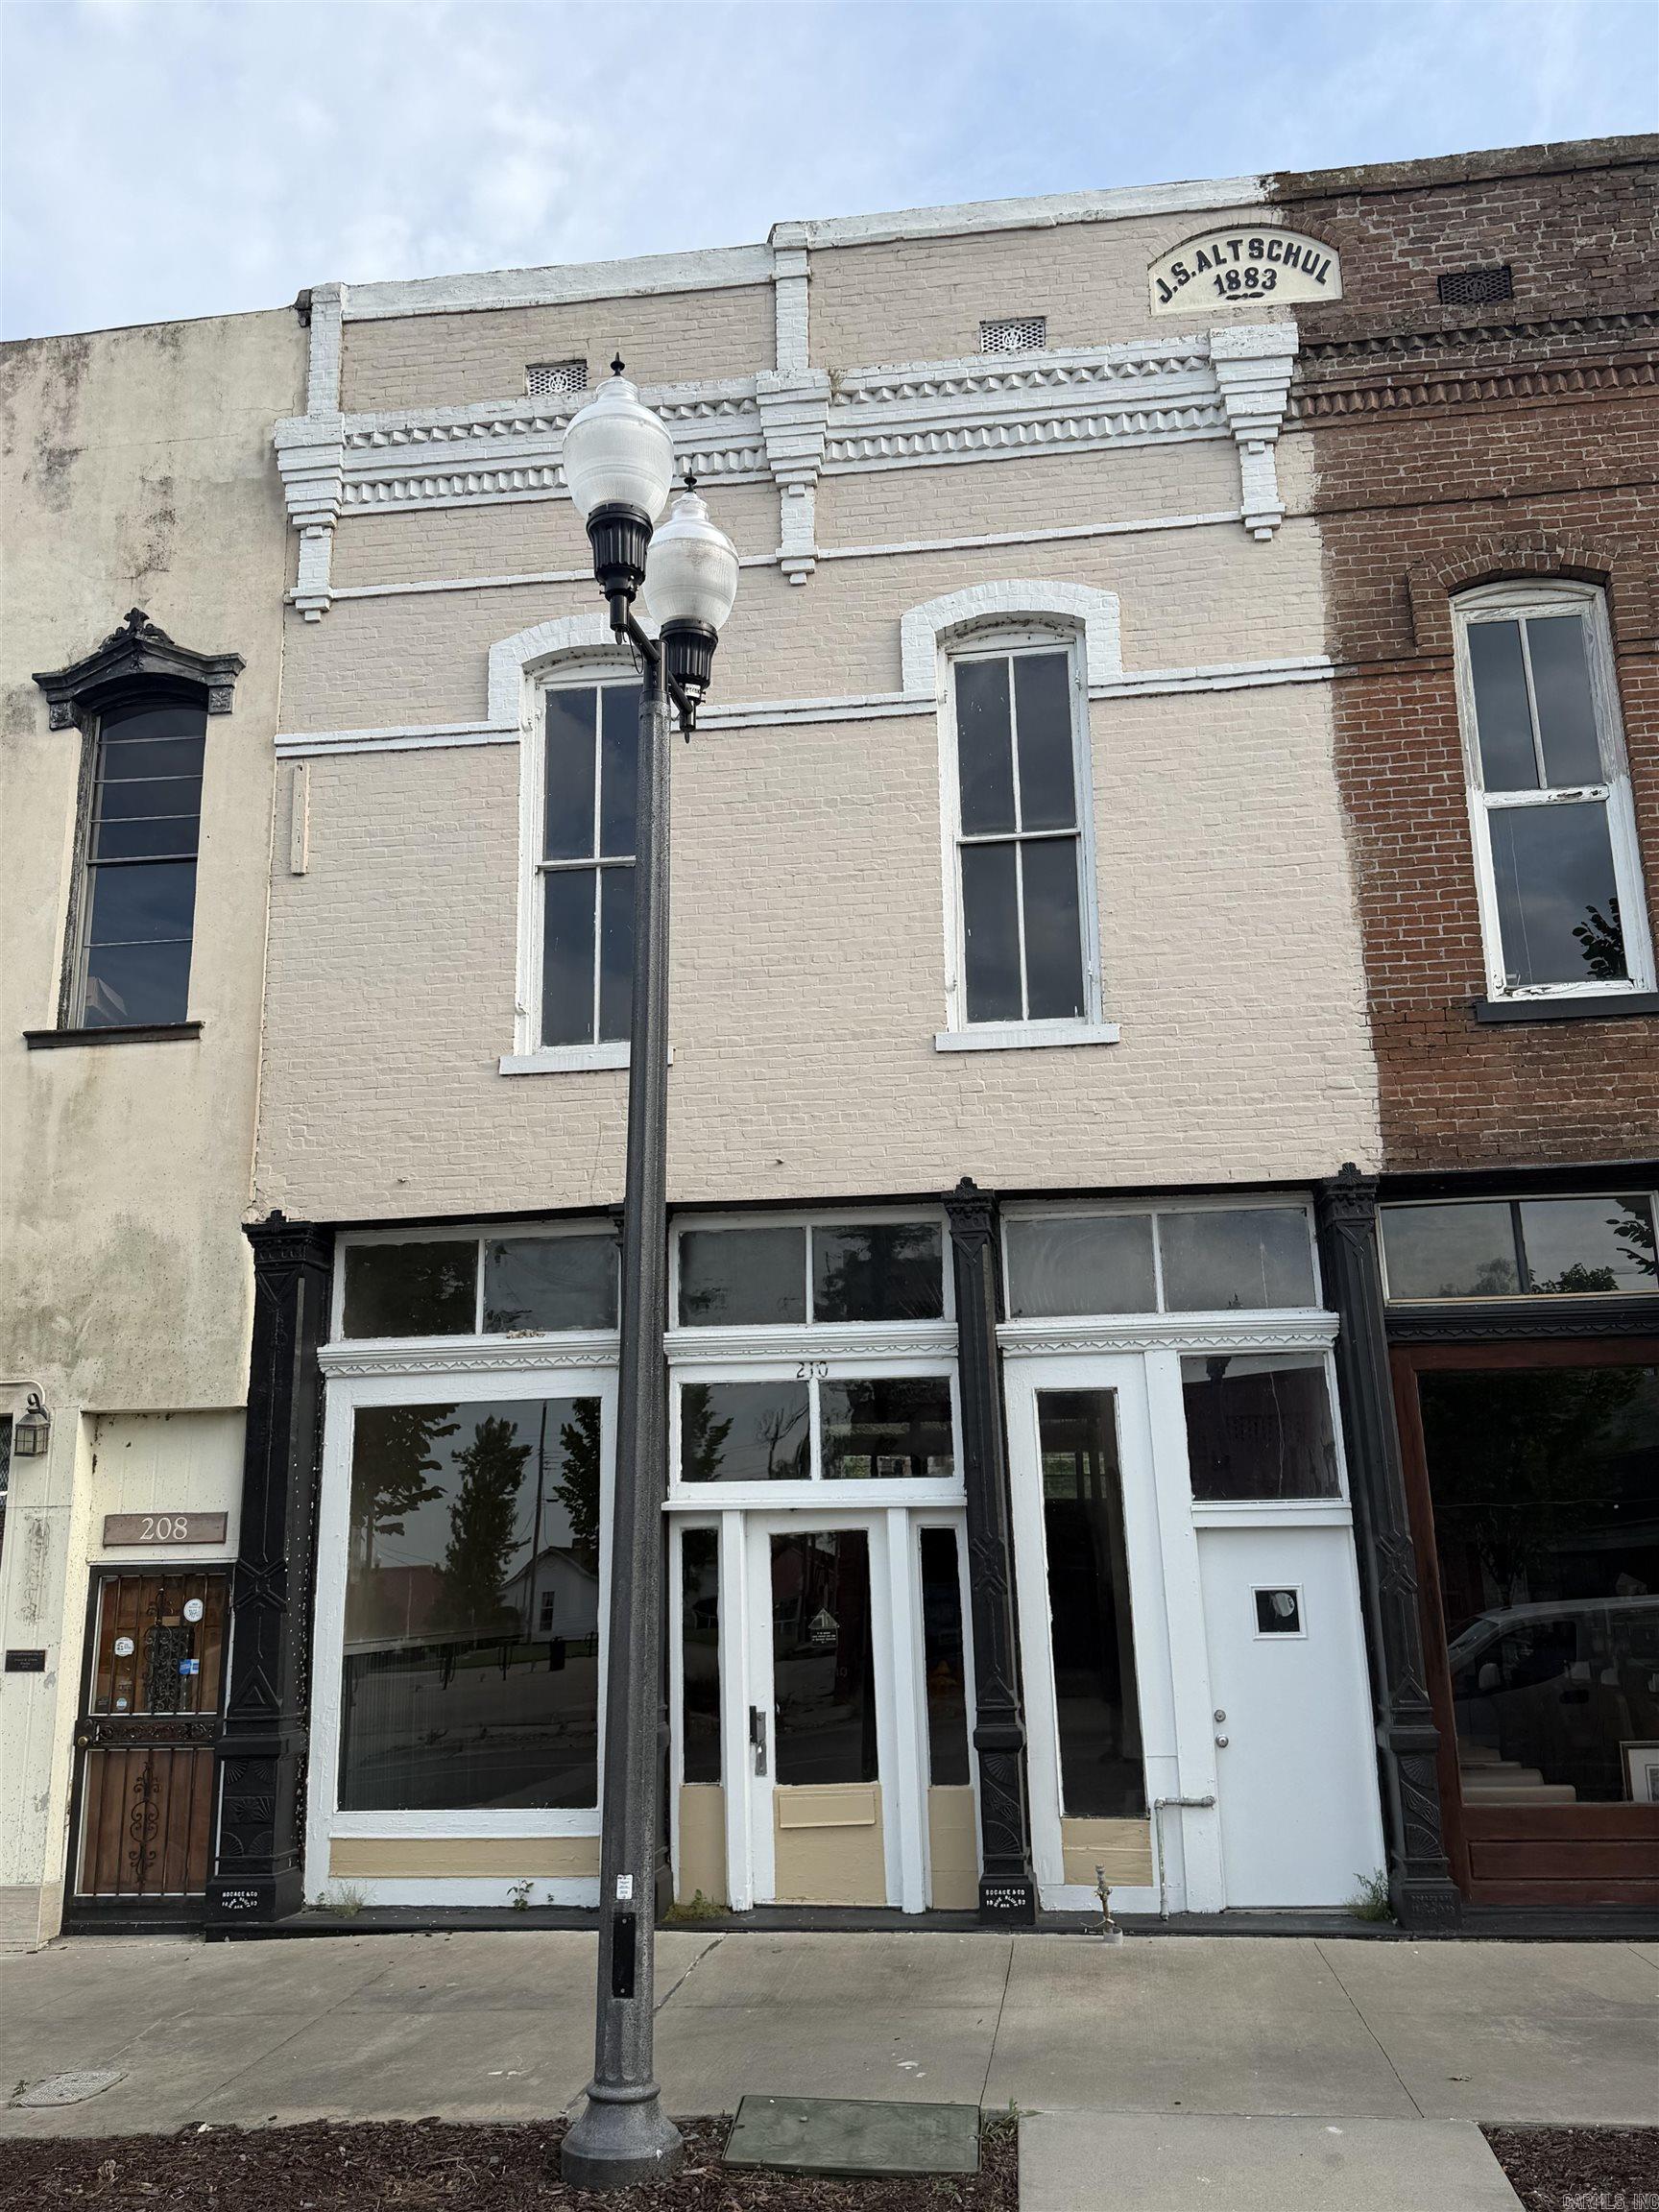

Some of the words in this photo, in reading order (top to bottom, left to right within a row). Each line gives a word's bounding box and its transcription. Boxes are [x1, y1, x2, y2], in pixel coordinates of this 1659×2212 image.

[1213, 267, 1278, 296] 1883
[797, 1361, 829, 1379] 210
[139, 1517, 188, 1541] 208
